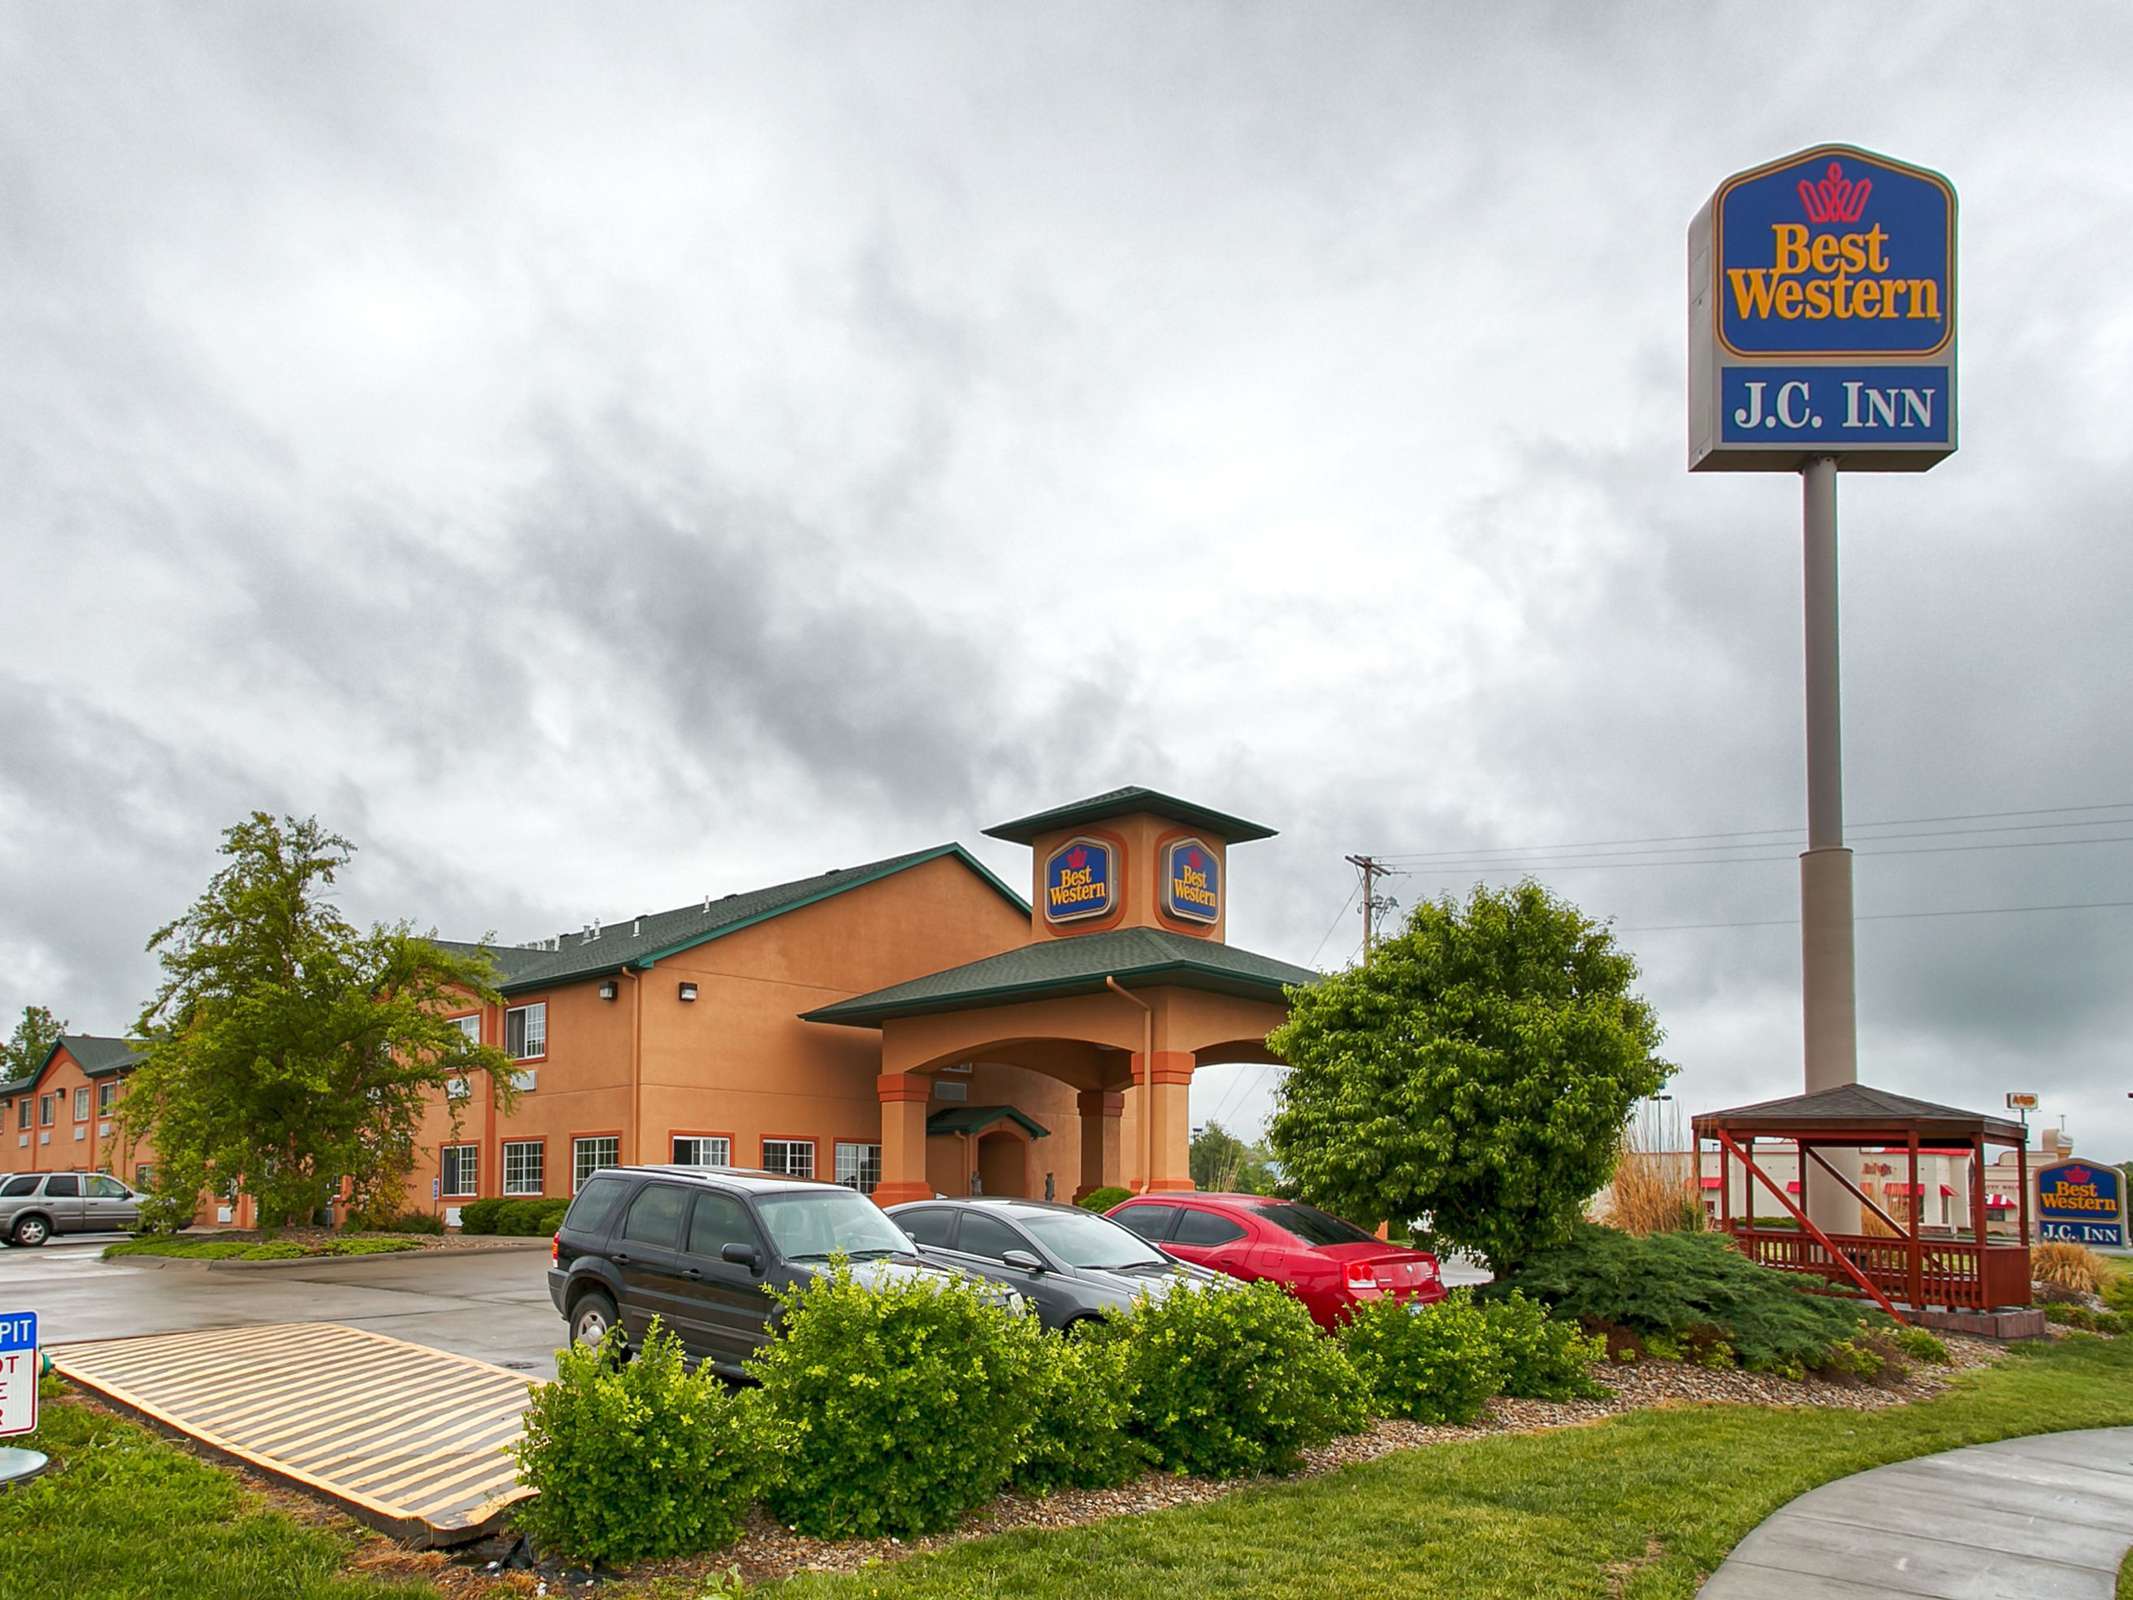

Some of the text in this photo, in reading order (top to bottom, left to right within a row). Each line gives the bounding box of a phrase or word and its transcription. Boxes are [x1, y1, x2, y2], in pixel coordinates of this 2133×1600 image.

[1772, 223, 1889, 275] Best
[1726, 268, 1941, 321] Western
[1734, 382, 1934, 428] J.C. INN
[1060, 865, 1092, 888] Best
[1183, 865, 1207, 888] Best
[1050, 882, 1105, 905] Western
[1174, 879, 1216, 907] Western
[2055, 1181, 2097, 1197] Best
[2041, 1193, 2116, 1210] Western
[2043, 1223, 2118, 1242] J.C. INN
